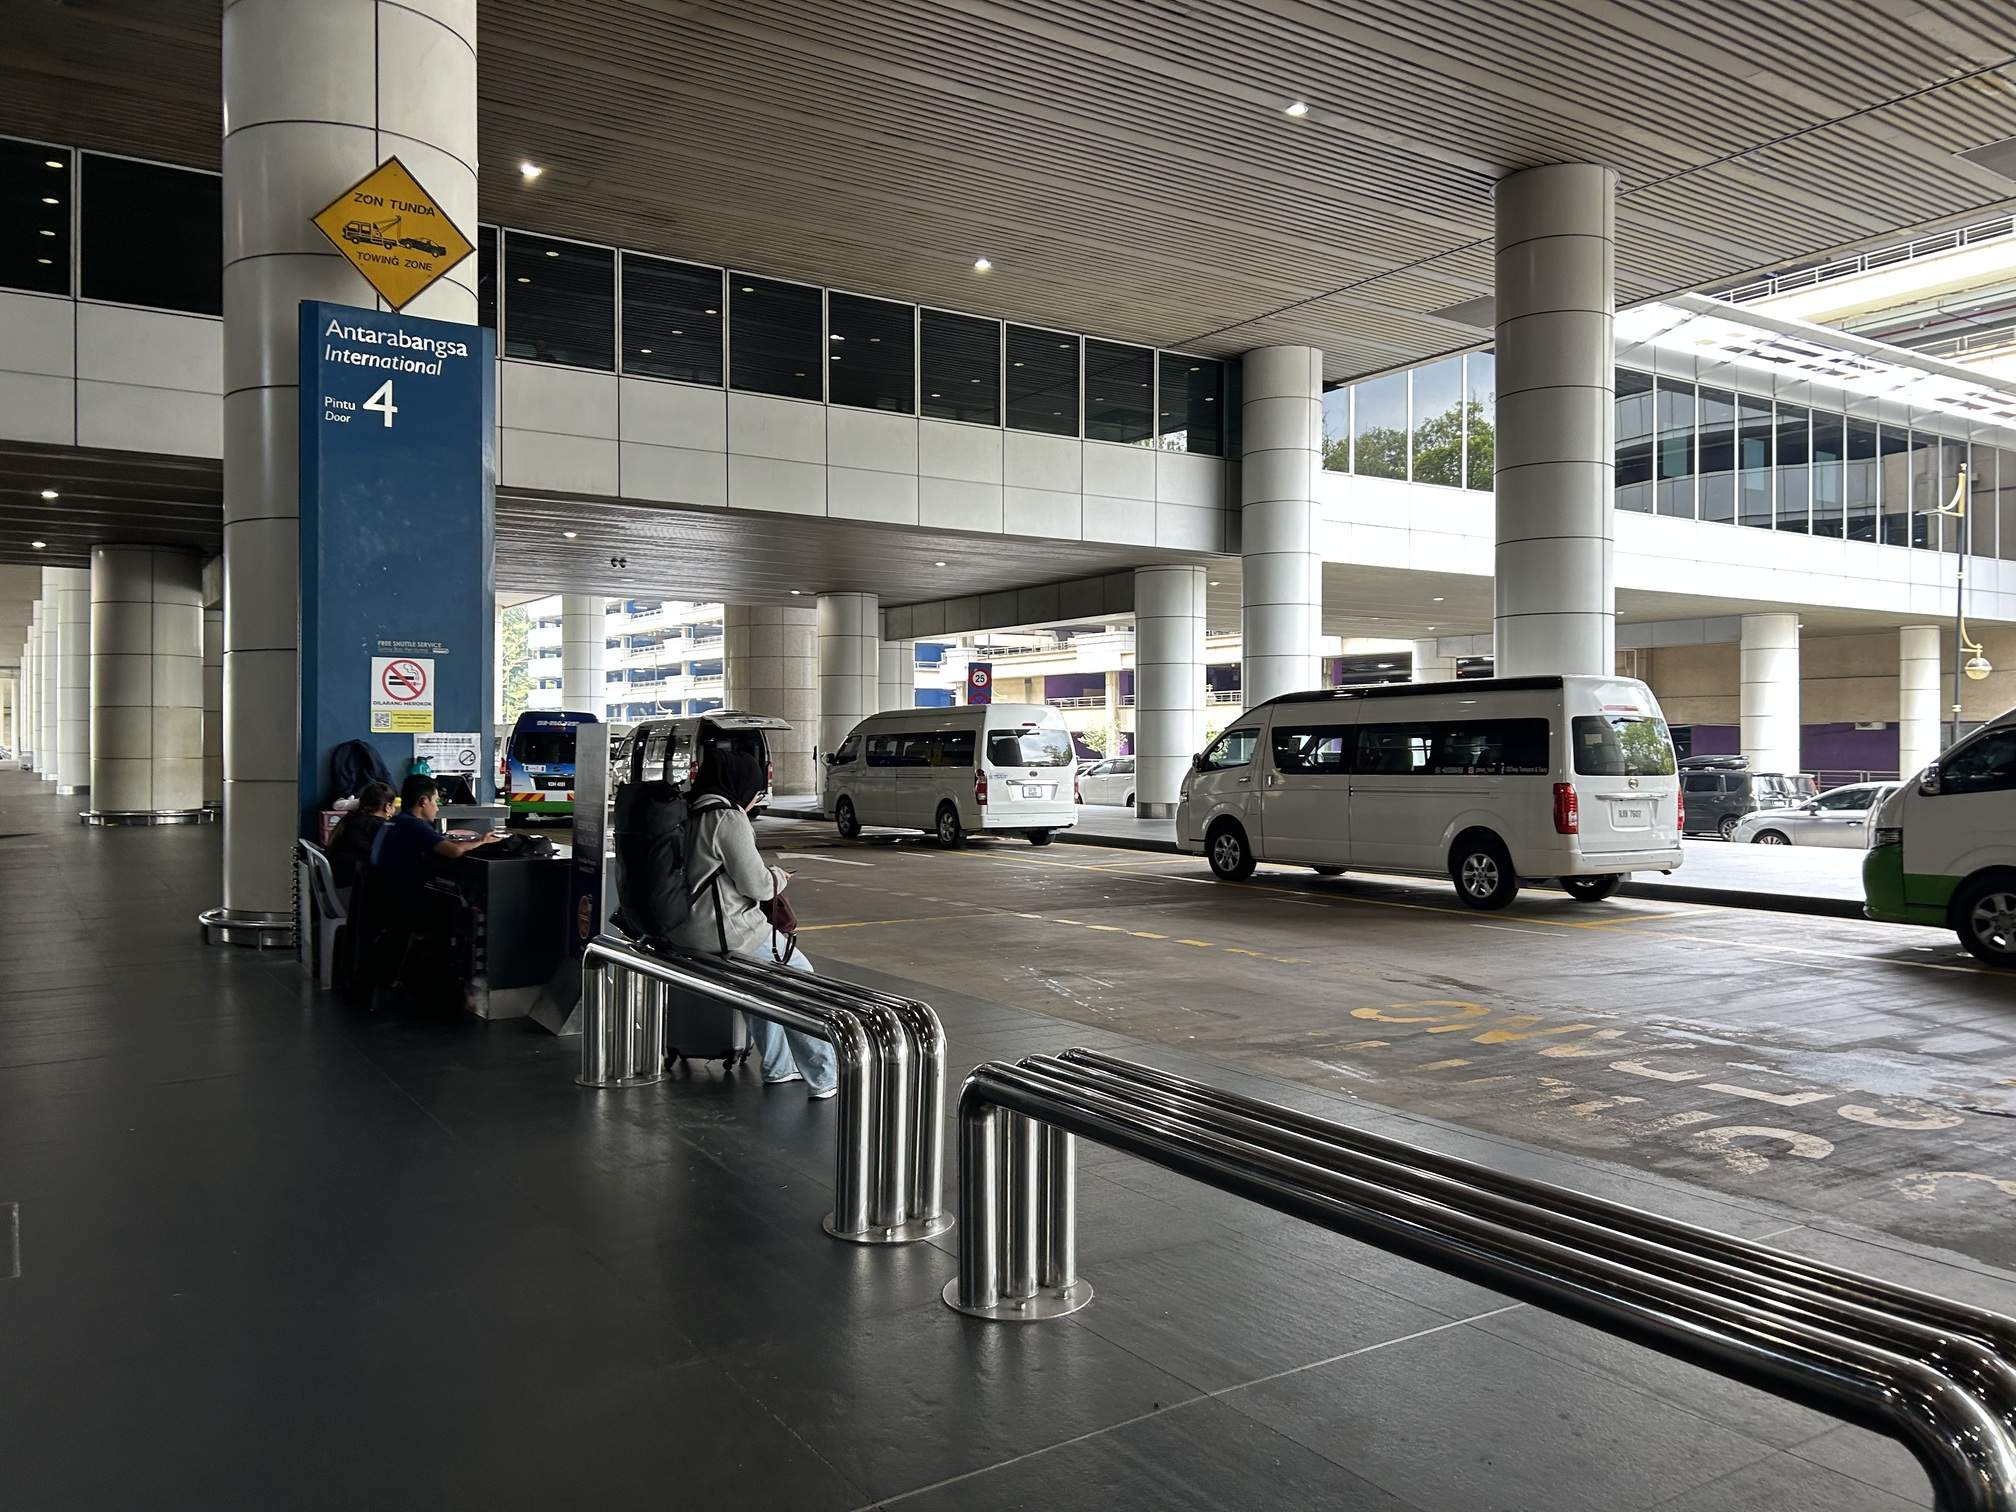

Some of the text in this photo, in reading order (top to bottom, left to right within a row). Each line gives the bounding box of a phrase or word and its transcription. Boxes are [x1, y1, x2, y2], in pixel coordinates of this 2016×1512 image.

[354, 192, 436, 217] ZON TUNDA
[357, 251, 433, 272] TOWING ZONE
[325, 319, 468, 359] Antarabangsa
[325, 344, 442, 376] International
[324, 396, 356, 411] Pintu
[362, 379, 398, 428] 4
[325, 410, 351, 423] Door
[393, 640, 416, 648] SHUTTLE
[975, 674, 985, 683] 25
